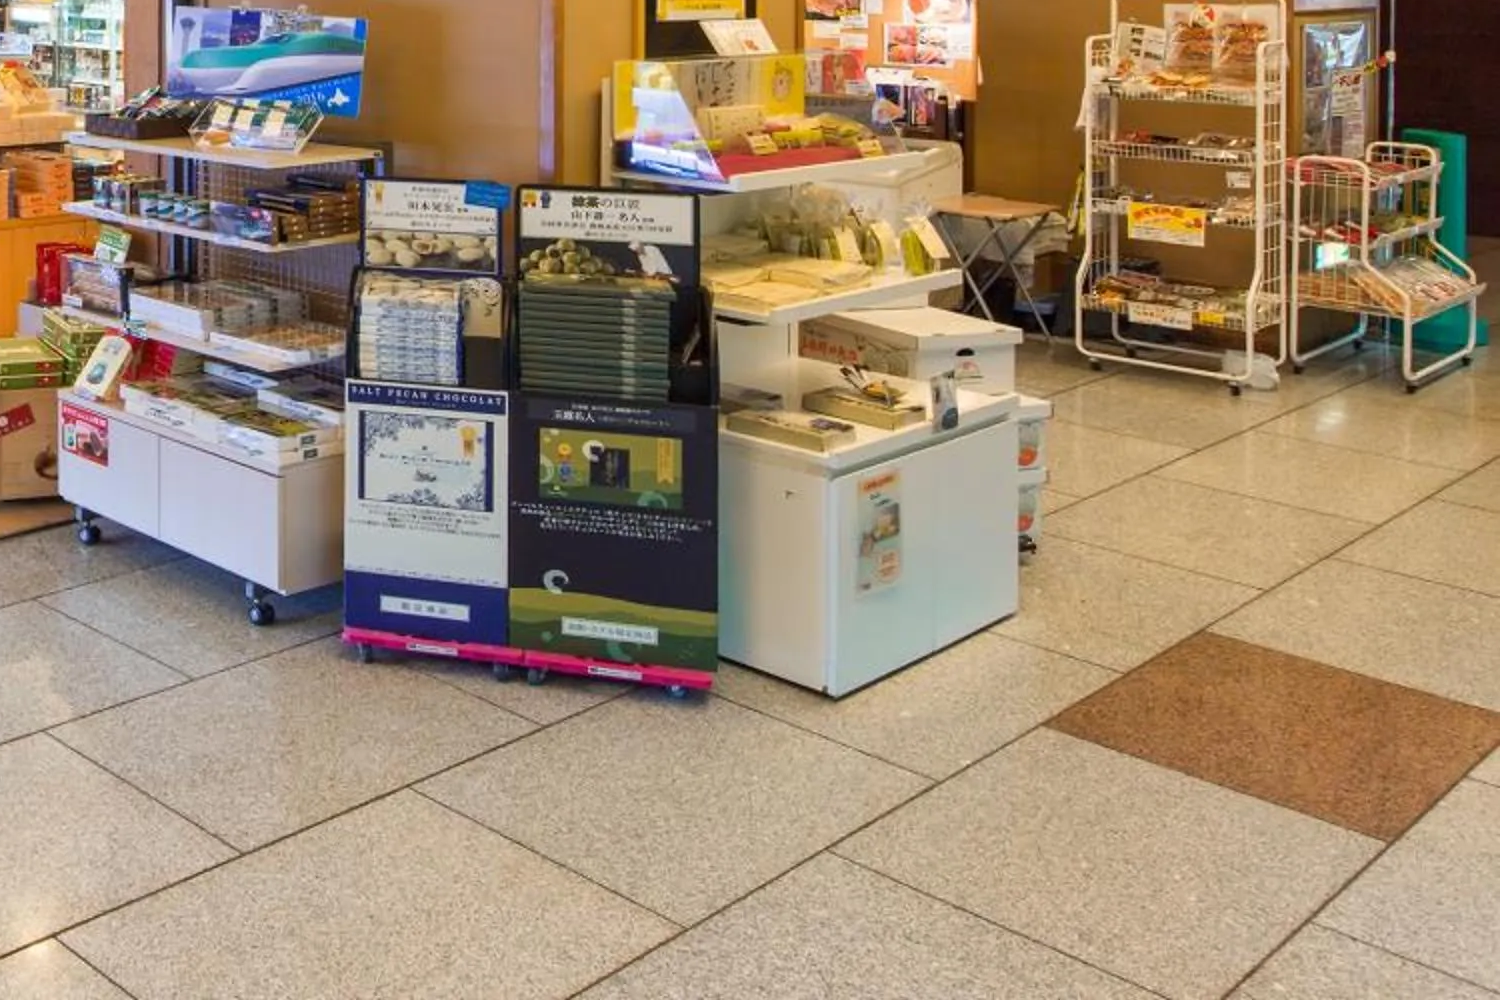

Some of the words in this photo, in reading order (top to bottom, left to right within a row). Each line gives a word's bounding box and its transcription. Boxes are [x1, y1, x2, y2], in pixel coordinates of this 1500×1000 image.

[351, 385, 381, 396] SALT
[387, 389, 428, 401] PECAN
[434, 393, 503, 406] CHOCOLAT
